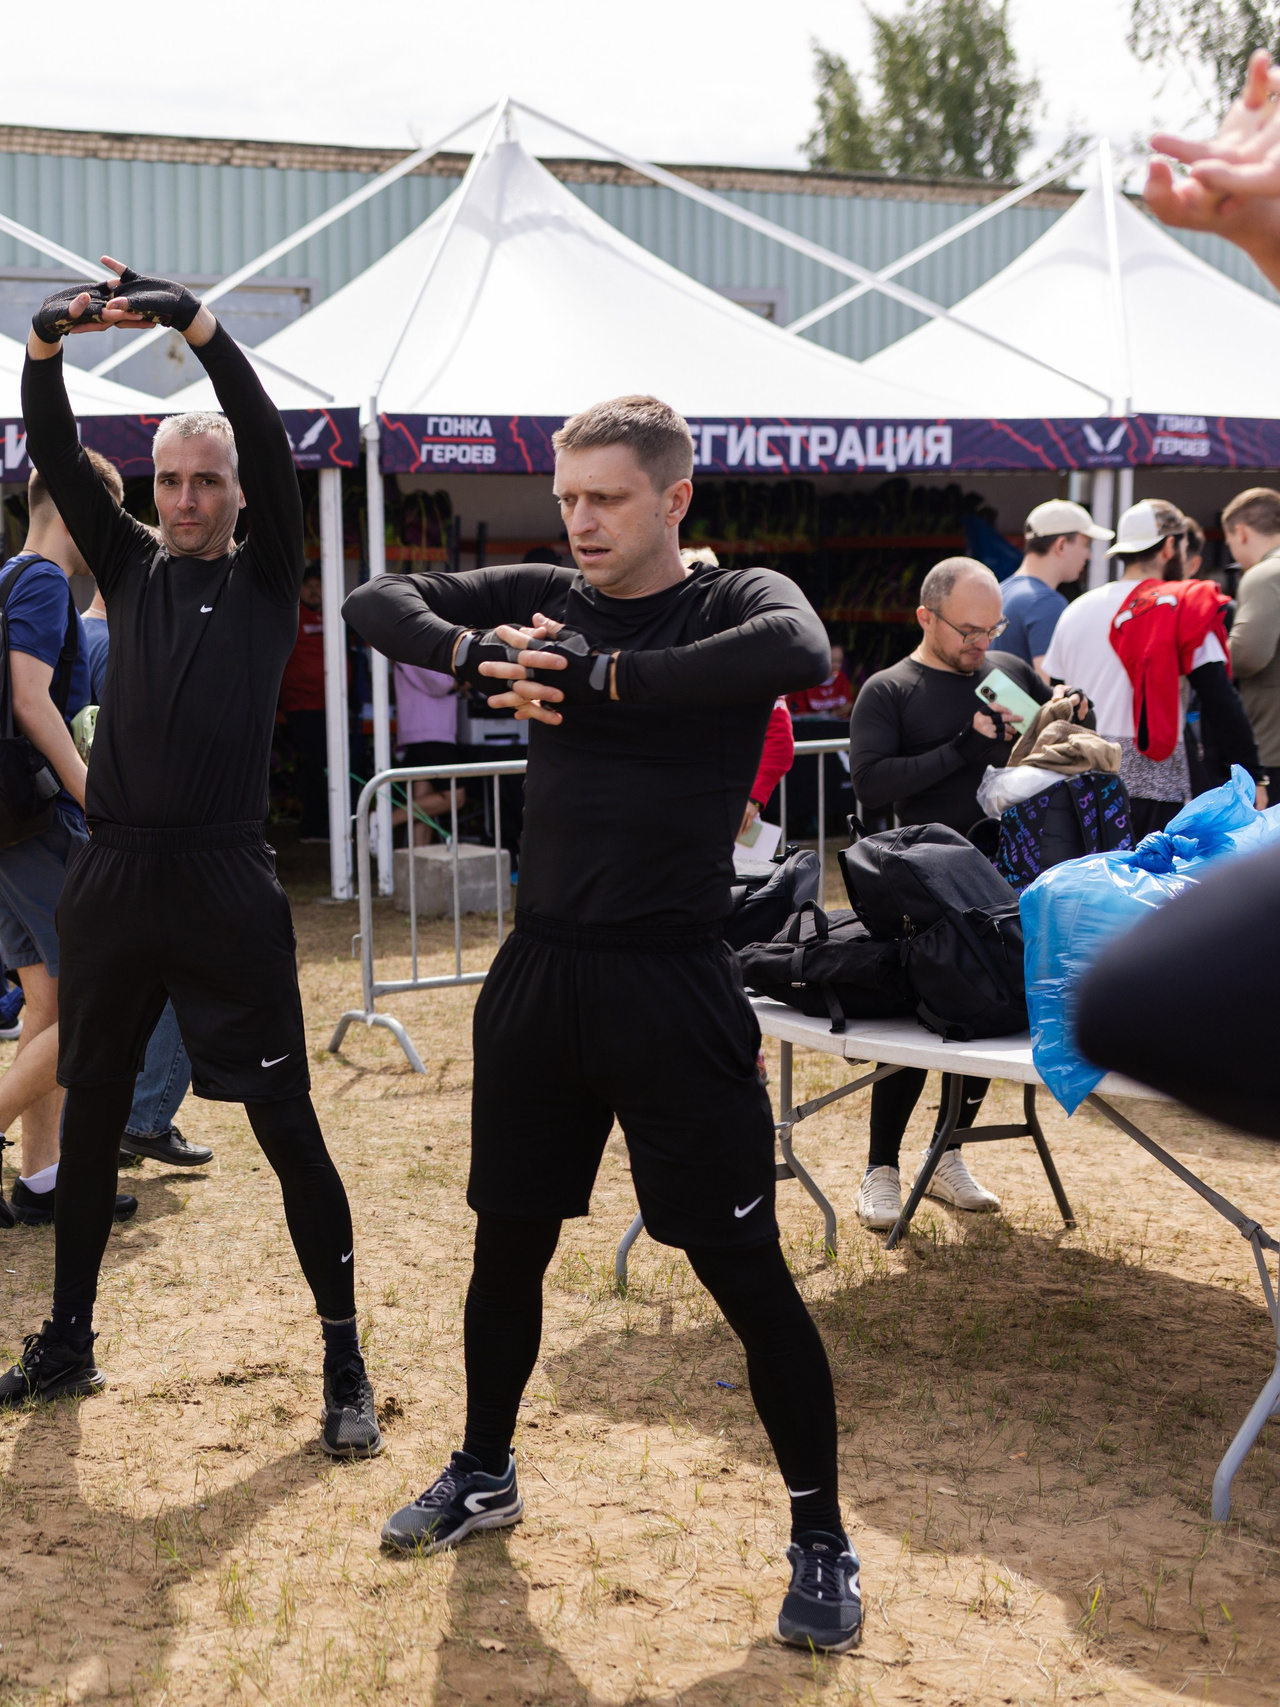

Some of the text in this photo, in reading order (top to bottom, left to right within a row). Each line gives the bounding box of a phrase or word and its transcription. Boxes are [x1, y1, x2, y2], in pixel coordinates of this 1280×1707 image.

[427, 416, 493, 437] ГОНКА
[420, 444, 496, 464] ГЕРОЕВ
[688, 424, 952, 472] ГИСТРАЦИЯ
